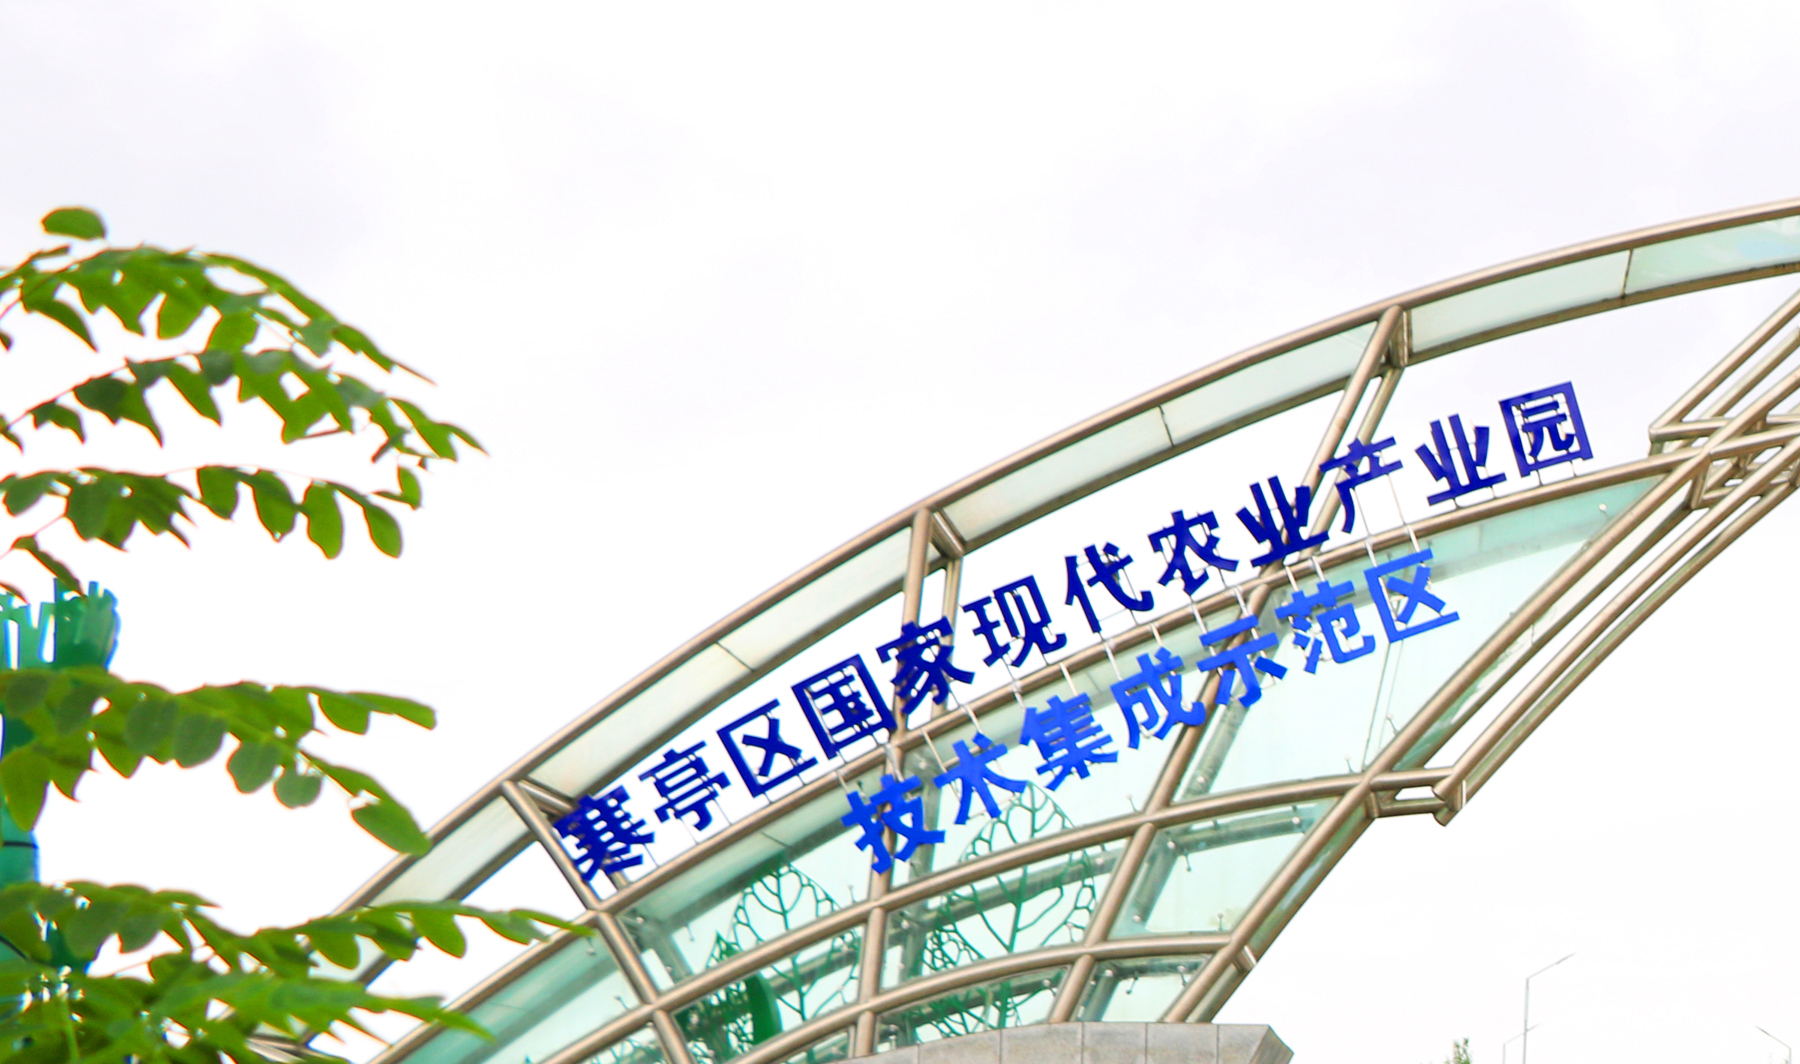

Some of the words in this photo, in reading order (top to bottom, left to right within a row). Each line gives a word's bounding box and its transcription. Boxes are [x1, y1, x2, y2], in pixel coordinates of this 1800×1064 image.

[554, 381, 1593, 887] 寒亭区国家现代农业产业园
[841, 548, 1459, 873] 技术集成示范区
